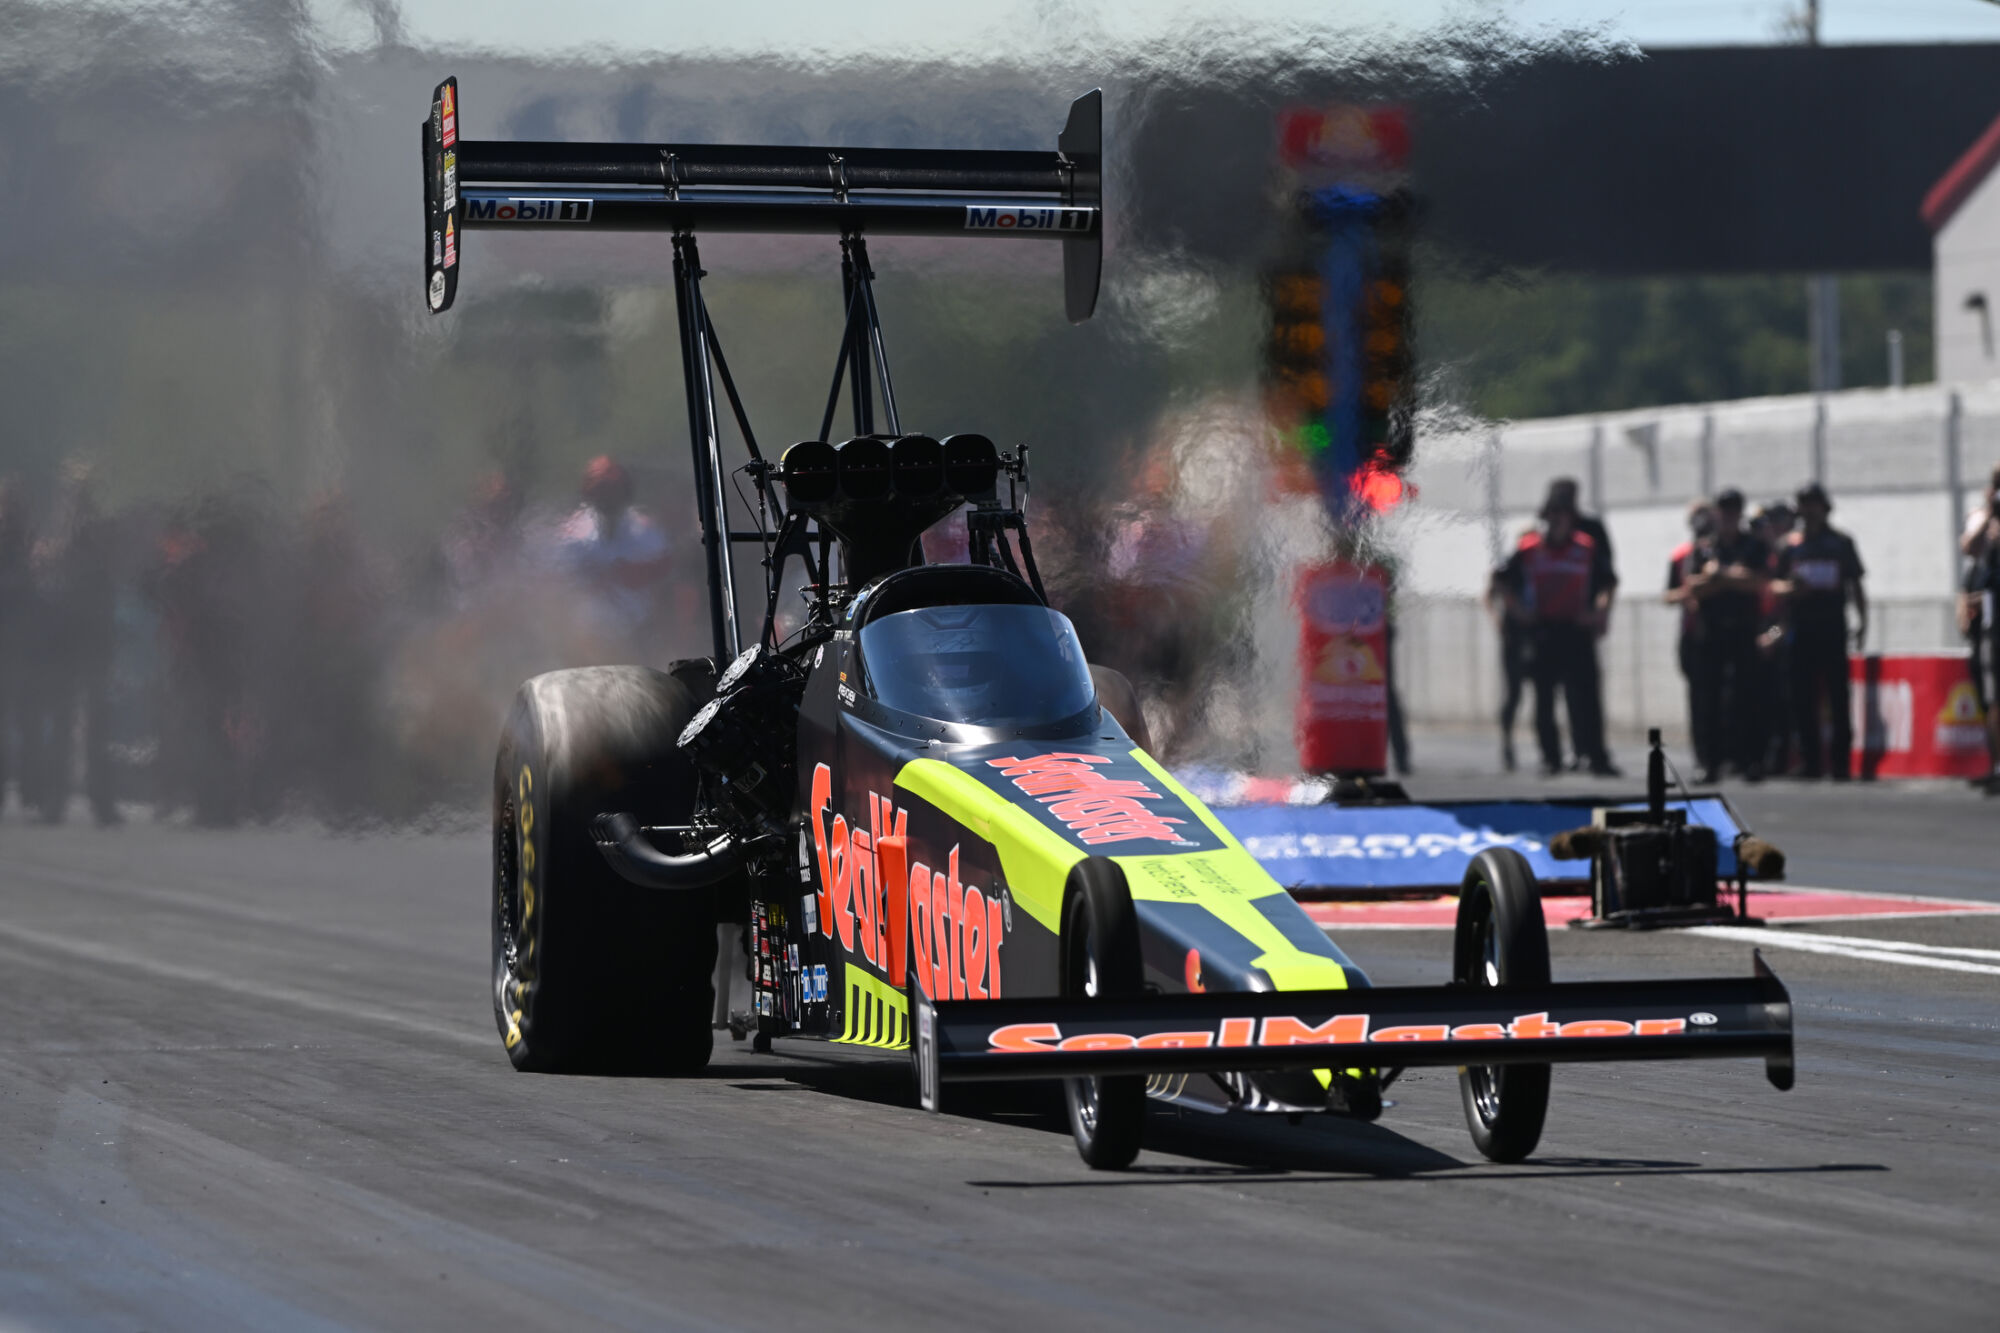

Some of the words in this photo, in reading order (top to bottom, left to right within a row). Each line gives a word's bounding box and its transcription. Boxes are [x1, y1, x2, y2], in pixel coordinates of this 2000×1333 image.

[468, 199, 554, 220] Mobil
[569, 202, 579, 219] 1
[969, 207, 1055, 228] Mobil
[1069, 211, 1079, 229] 1
[986, 1012, 1687, 1053] SealMaster
